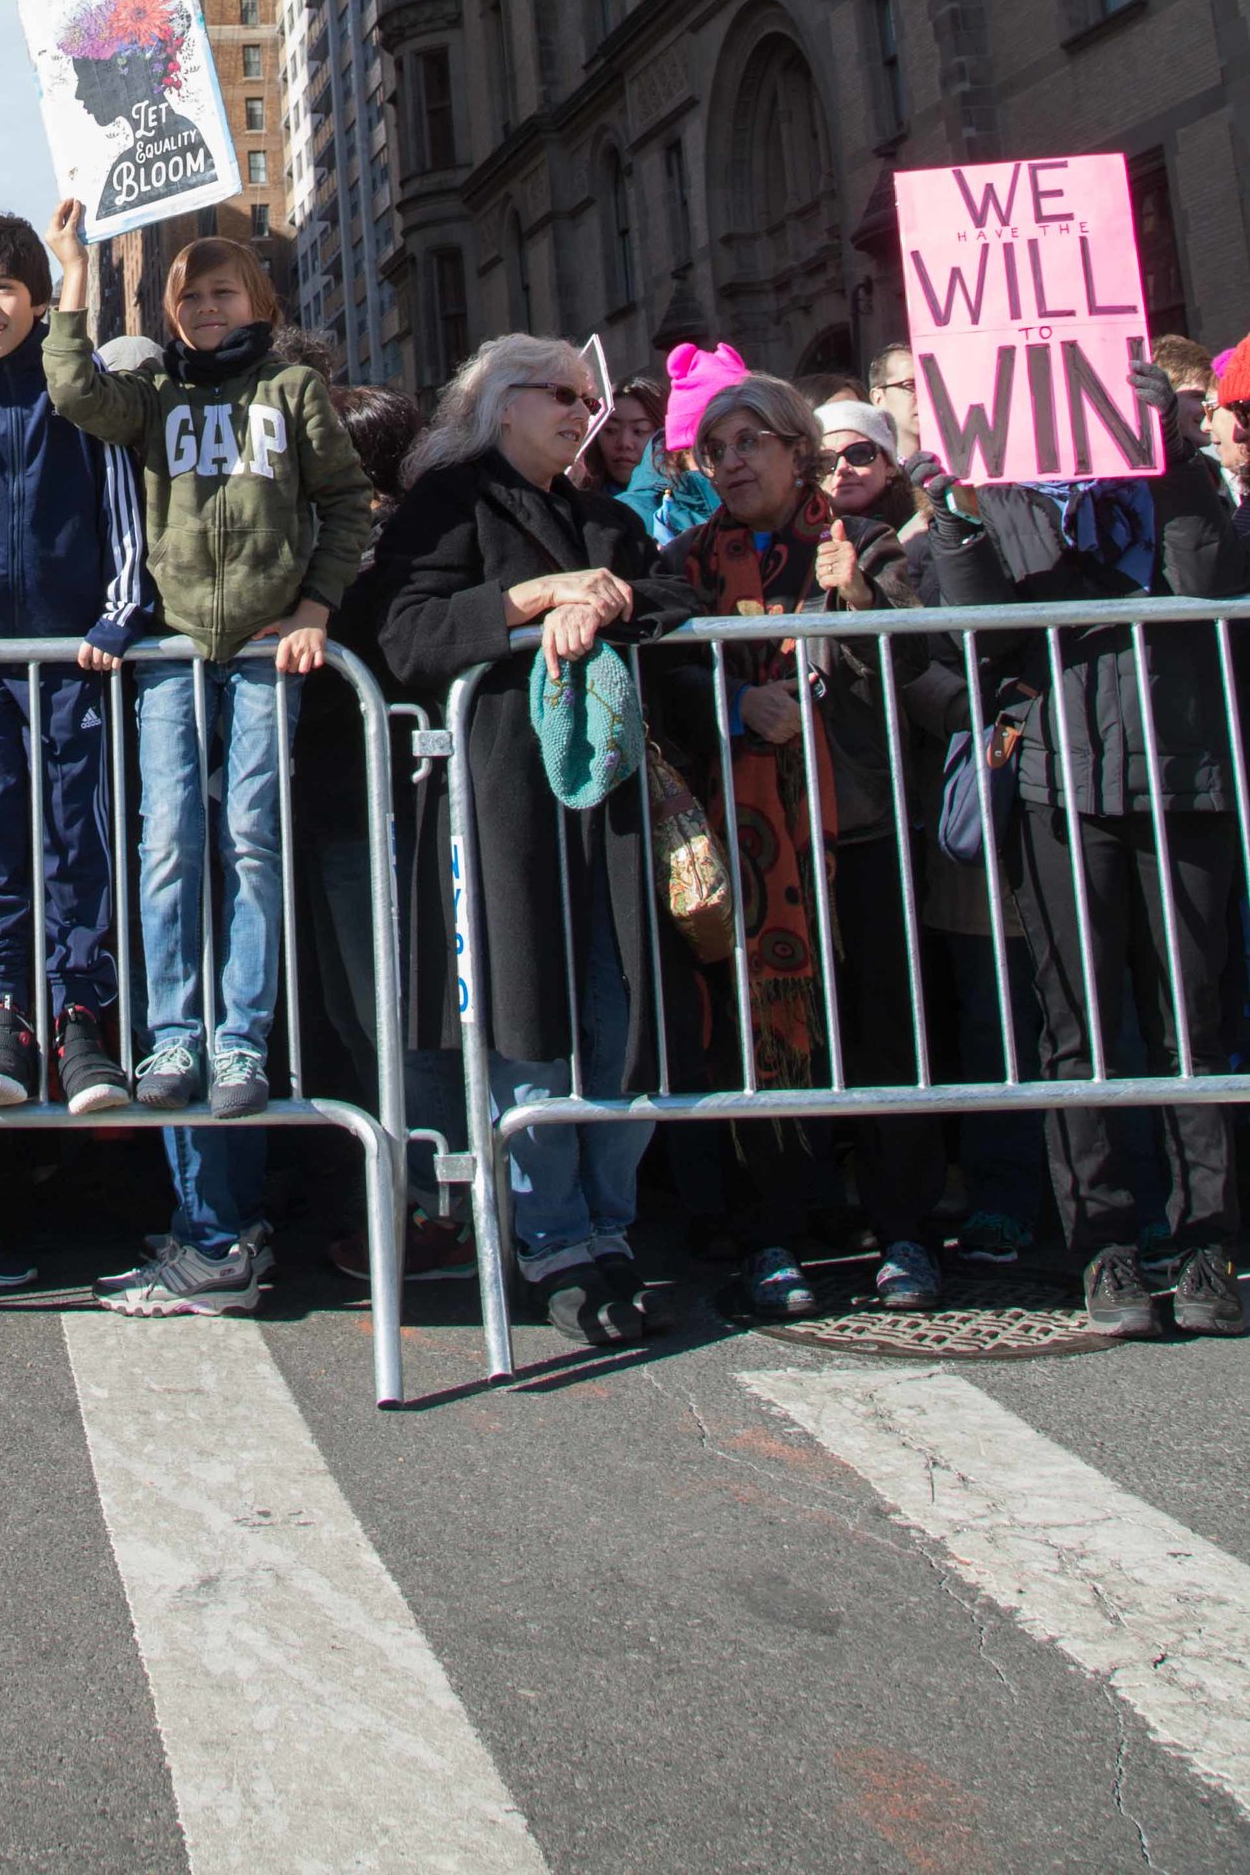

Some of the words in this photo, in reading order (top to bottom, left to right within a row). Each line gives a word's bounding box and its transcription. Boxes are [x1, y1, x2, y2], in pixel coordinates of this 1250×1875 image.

[131, 99, 169, 139] LET
[135, 128, 198, 164] EQUALITY
[112, 147, 206, 206] BLOOM
[952, 160, 1075, 229] WE
[957, 226, 1020, 243] HAVE
[1037, 221, 1091, 238] THE
[910, 235, 1139, 327] WILL
[1017, 325, 1053, 340] TO
[918, 336, 1158, 480] WIN
[164, 402, 288, 480] GAP
